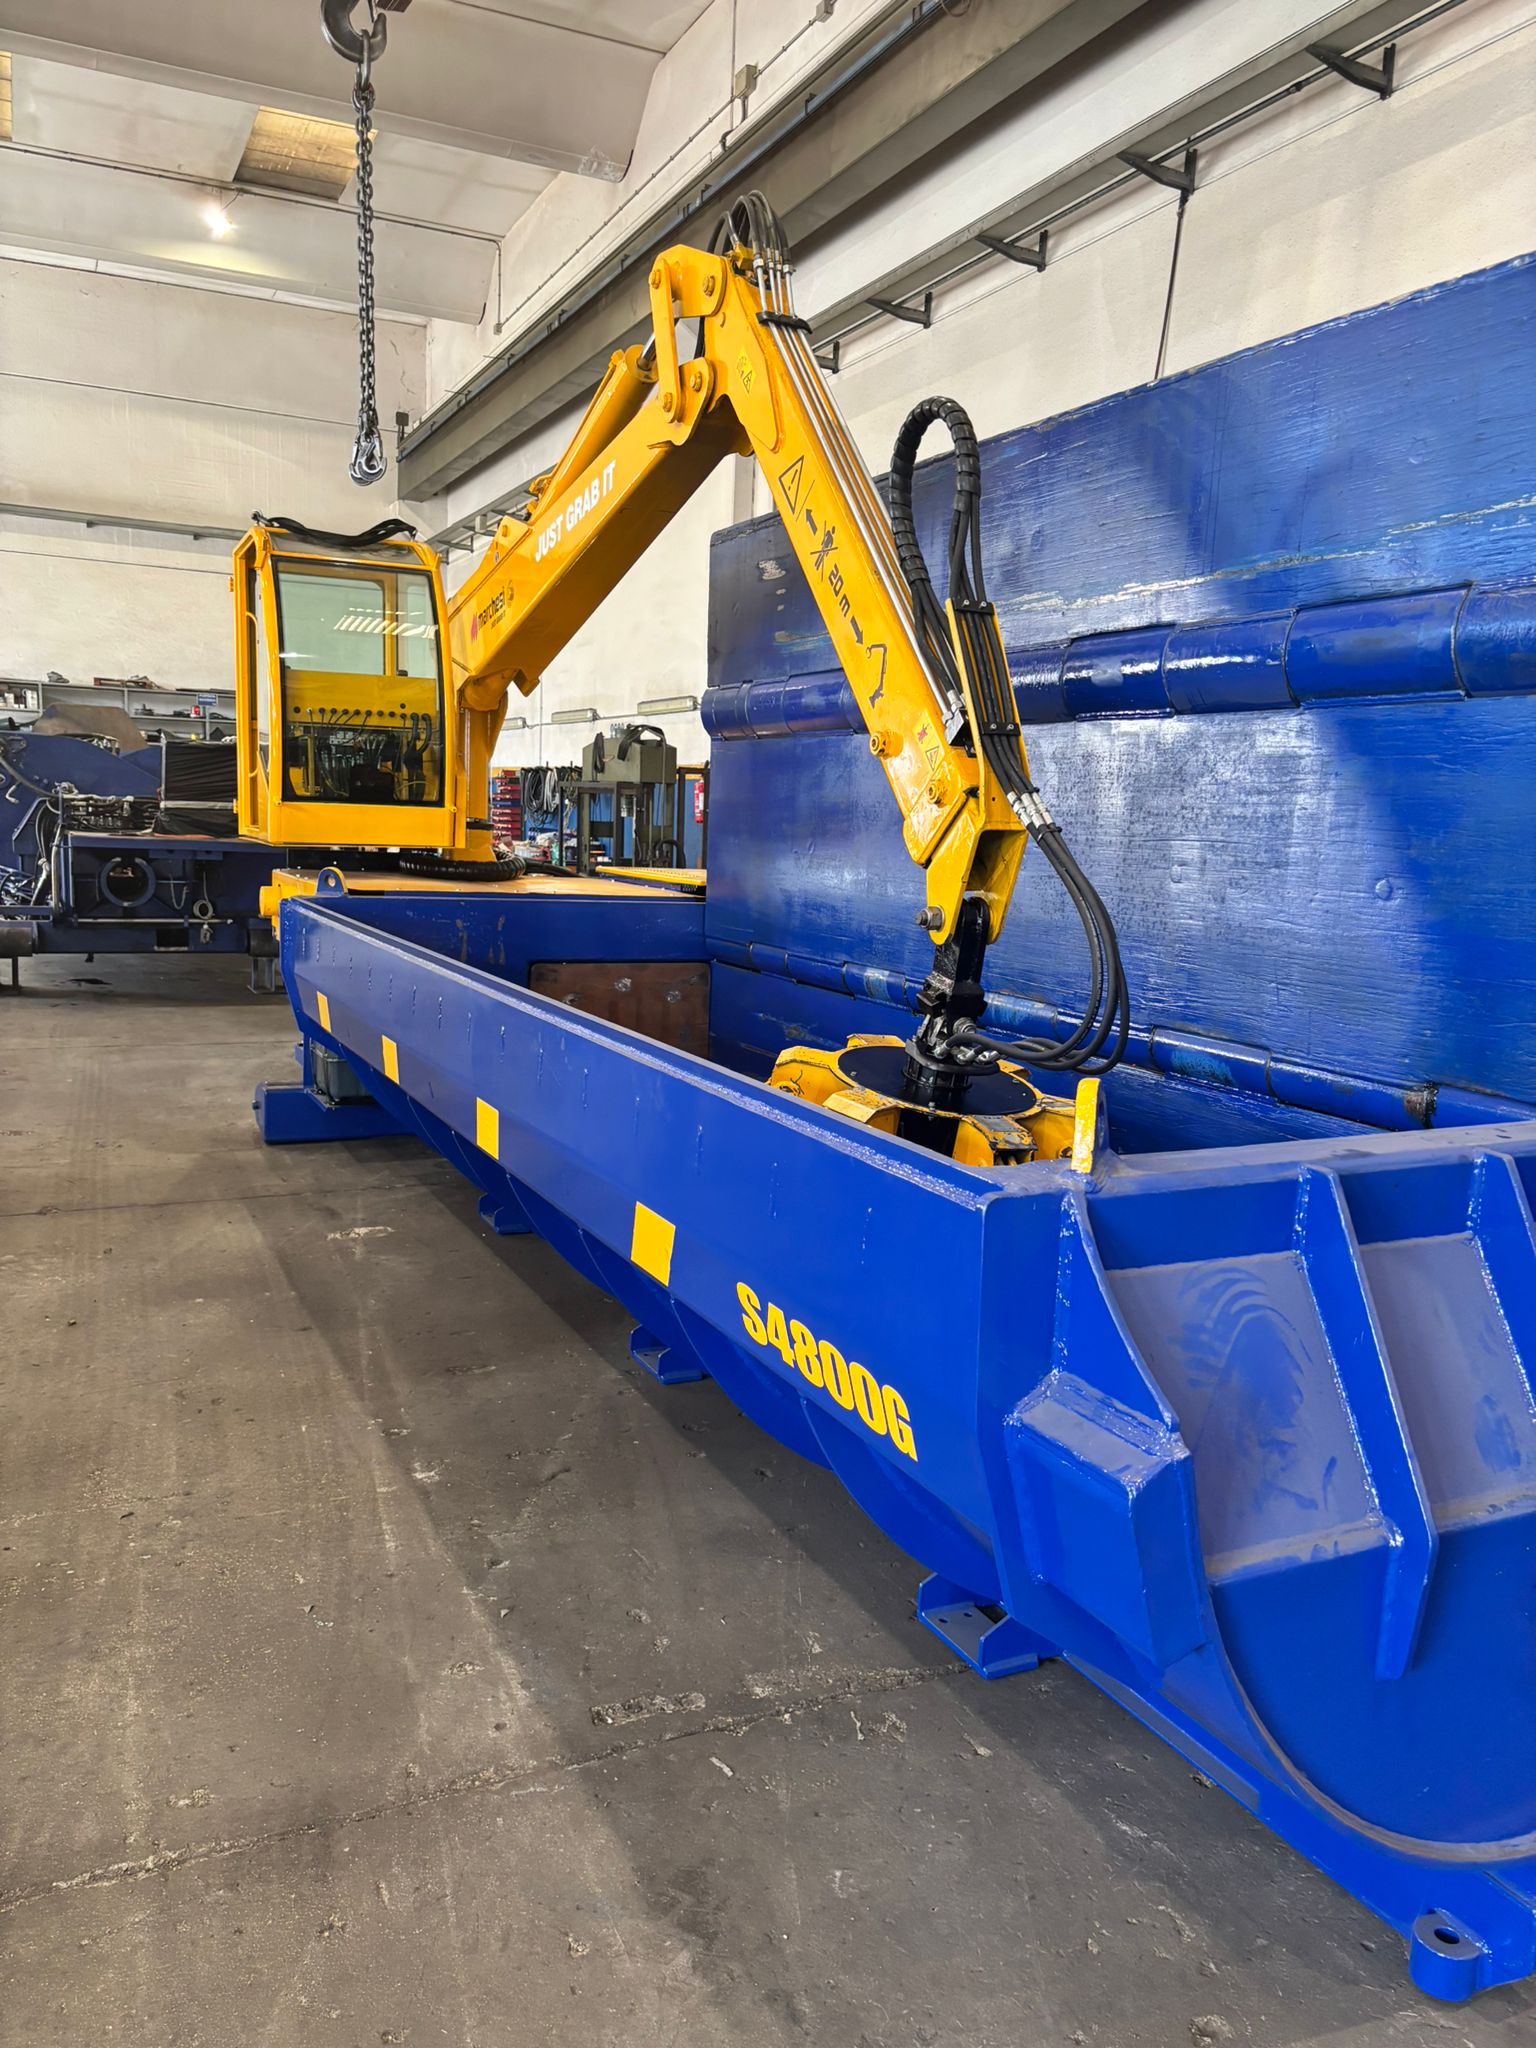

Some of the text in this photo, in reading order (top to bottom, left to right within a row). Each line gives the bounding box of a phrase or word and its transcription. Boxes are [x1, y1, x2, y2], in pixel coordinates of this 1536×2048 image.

[535, 459, 616, 562] JUST GRAB IT
[828, 563, 850, 618] 20 m
[736, 1281, 918, 1462] S4800G
